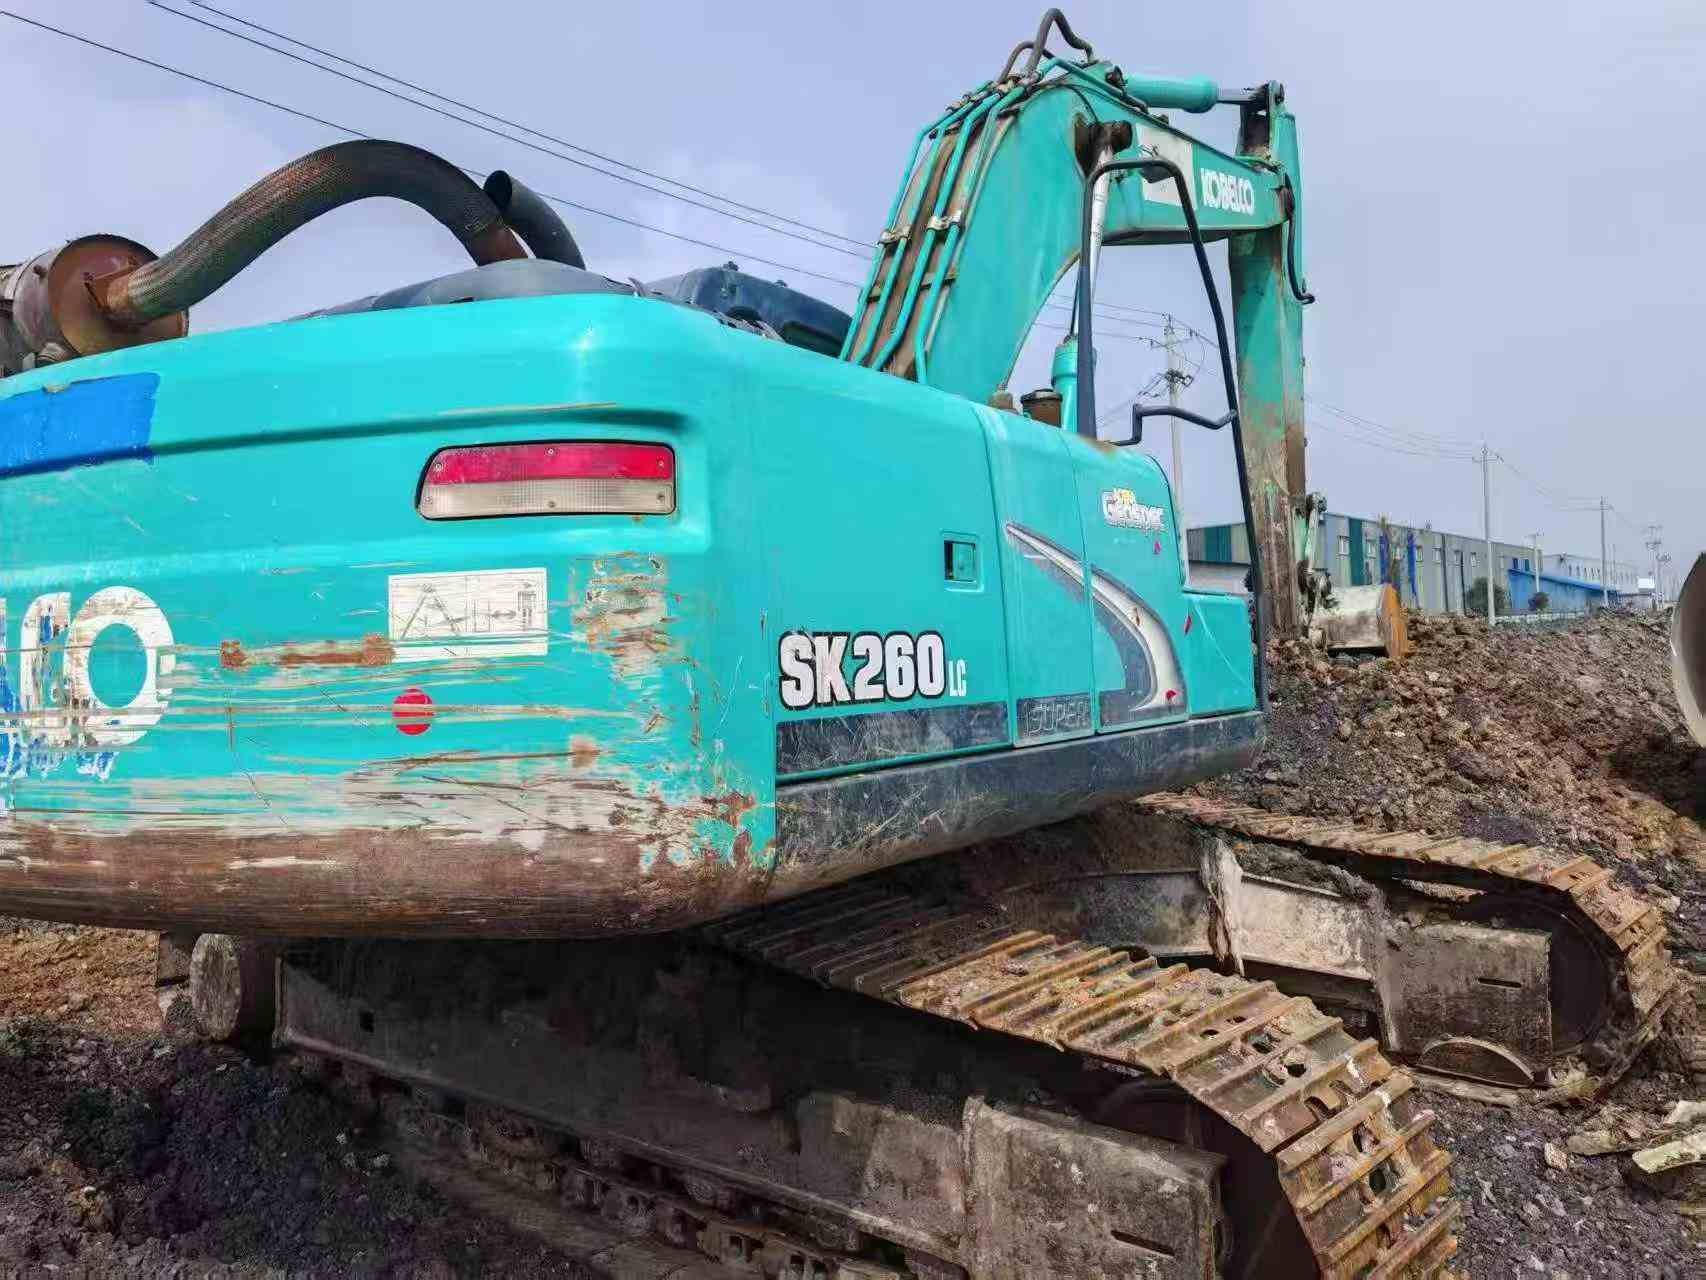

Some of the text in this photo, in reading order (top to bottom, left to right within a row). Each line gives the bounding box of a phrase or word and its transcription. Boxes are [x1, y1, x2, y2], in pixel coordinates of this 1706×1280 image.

[1200, 168, 1254, 215] KOBELCO
[0, 585, 177, 746] CO
[779, 630, 969, 711] SK260 LC
